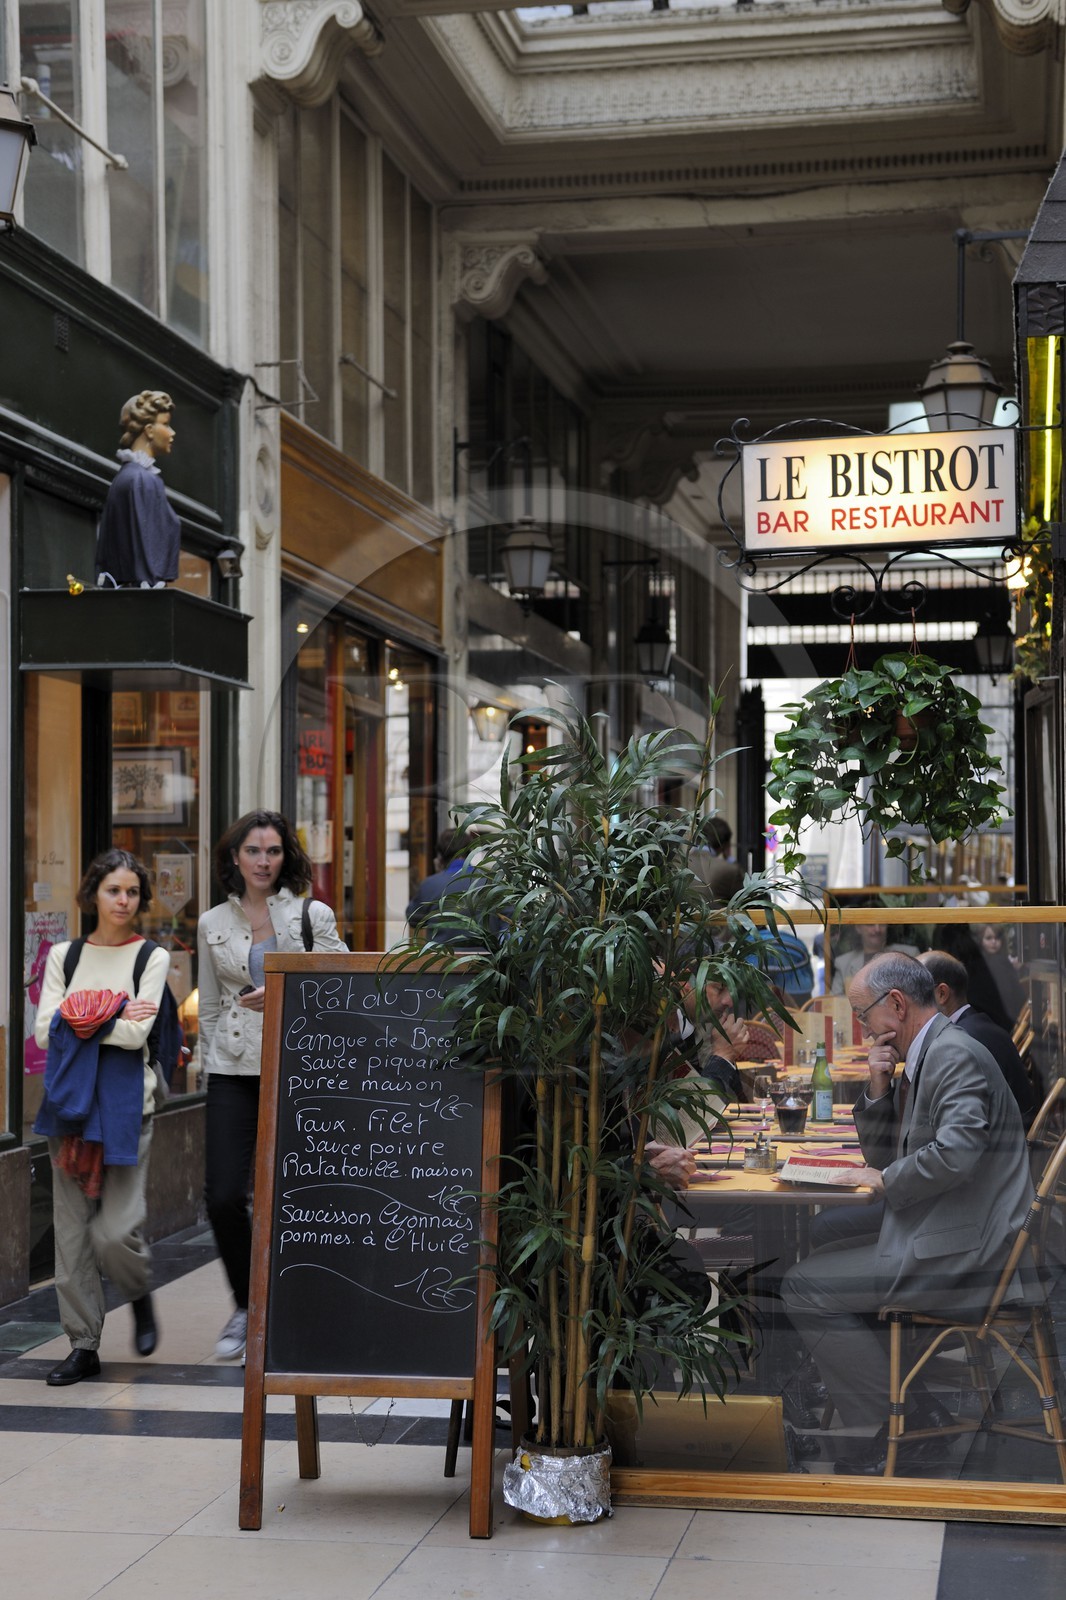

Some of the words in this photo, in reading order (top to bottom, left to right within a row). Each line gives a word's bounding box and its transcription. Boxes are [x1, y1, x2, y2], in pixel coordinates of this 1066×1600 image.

[756, 455, 808, 503] LE
[827, 443, 1005, 499] BISTROT
[757, 510, 810, 535] BAR
[831, 499, 1005, 532] RESTAURANT
[362, 977, 398, 1009] du
[400, 988, 449, 1017] Jou
[375, 1025, 398, 1048] de
[361, 1075, 443, 1091] maison
[369, 1141, 446, 1160] poivre
[411, 1162, 473, 1179] maison
[280, 1204, 371, 1225] Saucisson
[362, 1231, 377, 1246] à
